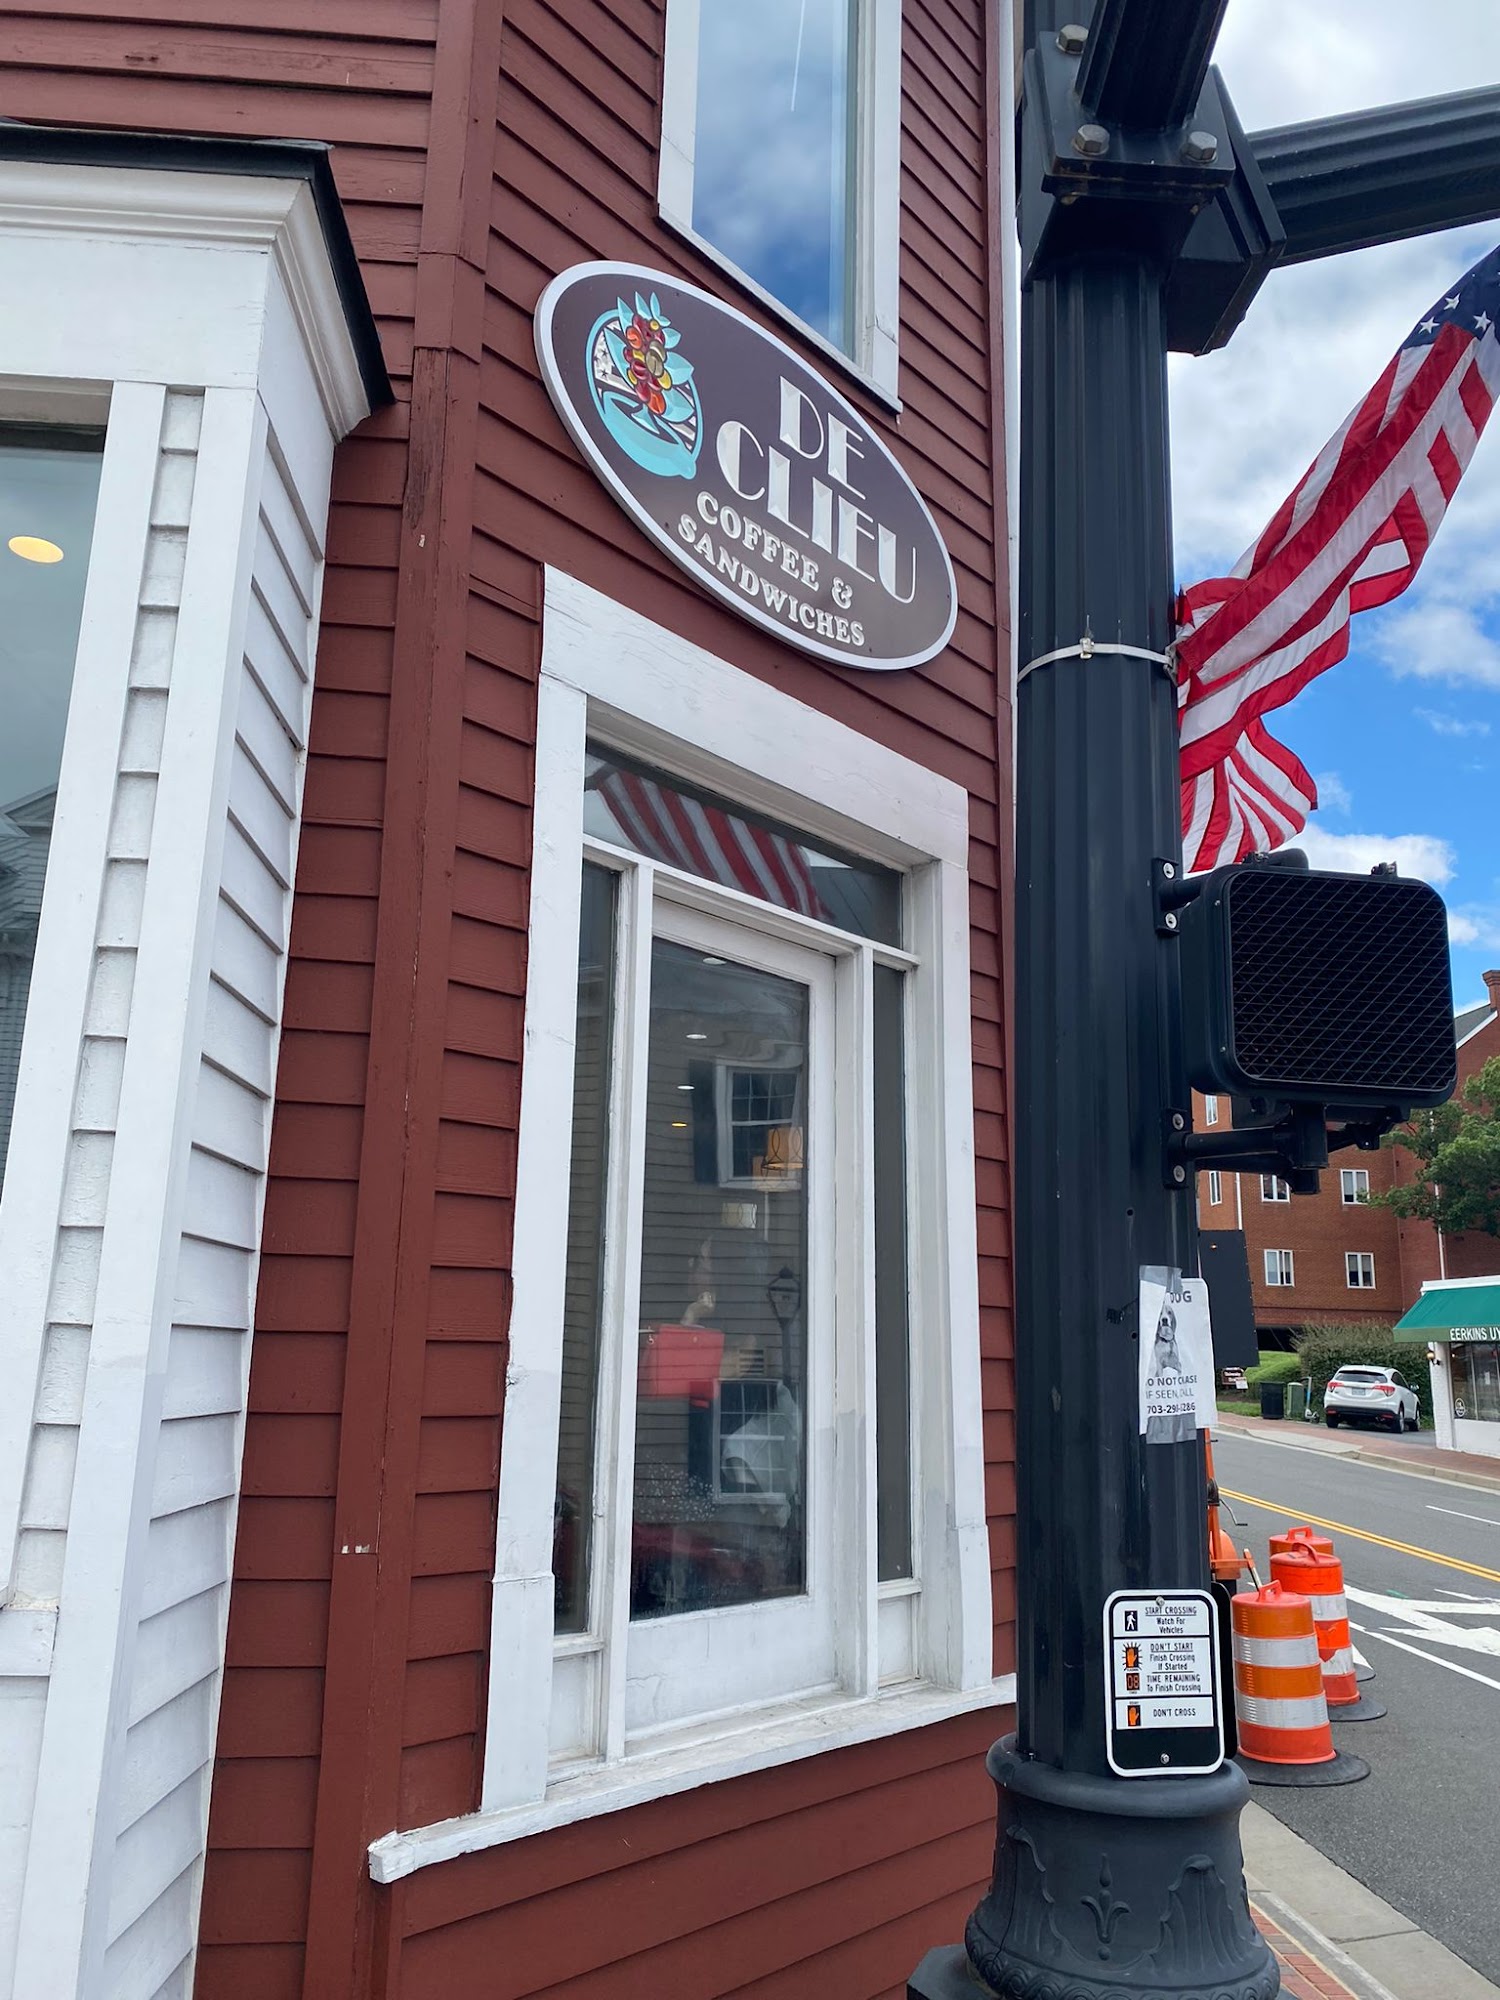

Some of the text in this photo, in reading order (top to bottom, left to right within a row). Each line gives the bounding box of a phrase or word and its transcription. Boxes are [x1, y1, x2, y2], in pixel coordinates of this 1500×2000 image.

[779, 376, 866, 500] DE
[716, 420, 916, 604] CLIEU
[696, 490, 853, 609] COFFEE &
[678, 513, 865, 646] SANDWICHES
[1450, 1327, 1487, 1341] EERKINS
[1157, 1377, 1176, 1386] NOT
[1145, 1606, 1197, 1615] START CROSSING
[1156, 1617, 1185, 1625] Watch For
[1159, 1626, 1184, 1634] Vehicles
[1150, 1642, 1193, 1652] DON'T START
[1150, 1653, 1195, 1663] Finish Crossing
[1158, 1662, 1188, 1671] If Started
[1147, 1674, 1201, 1683] TIME REMAINING
[1147, 1683, 1201, 1693] To Finish Crossing
[1153, 1708, 1196, 1717] DON'T CROSS
